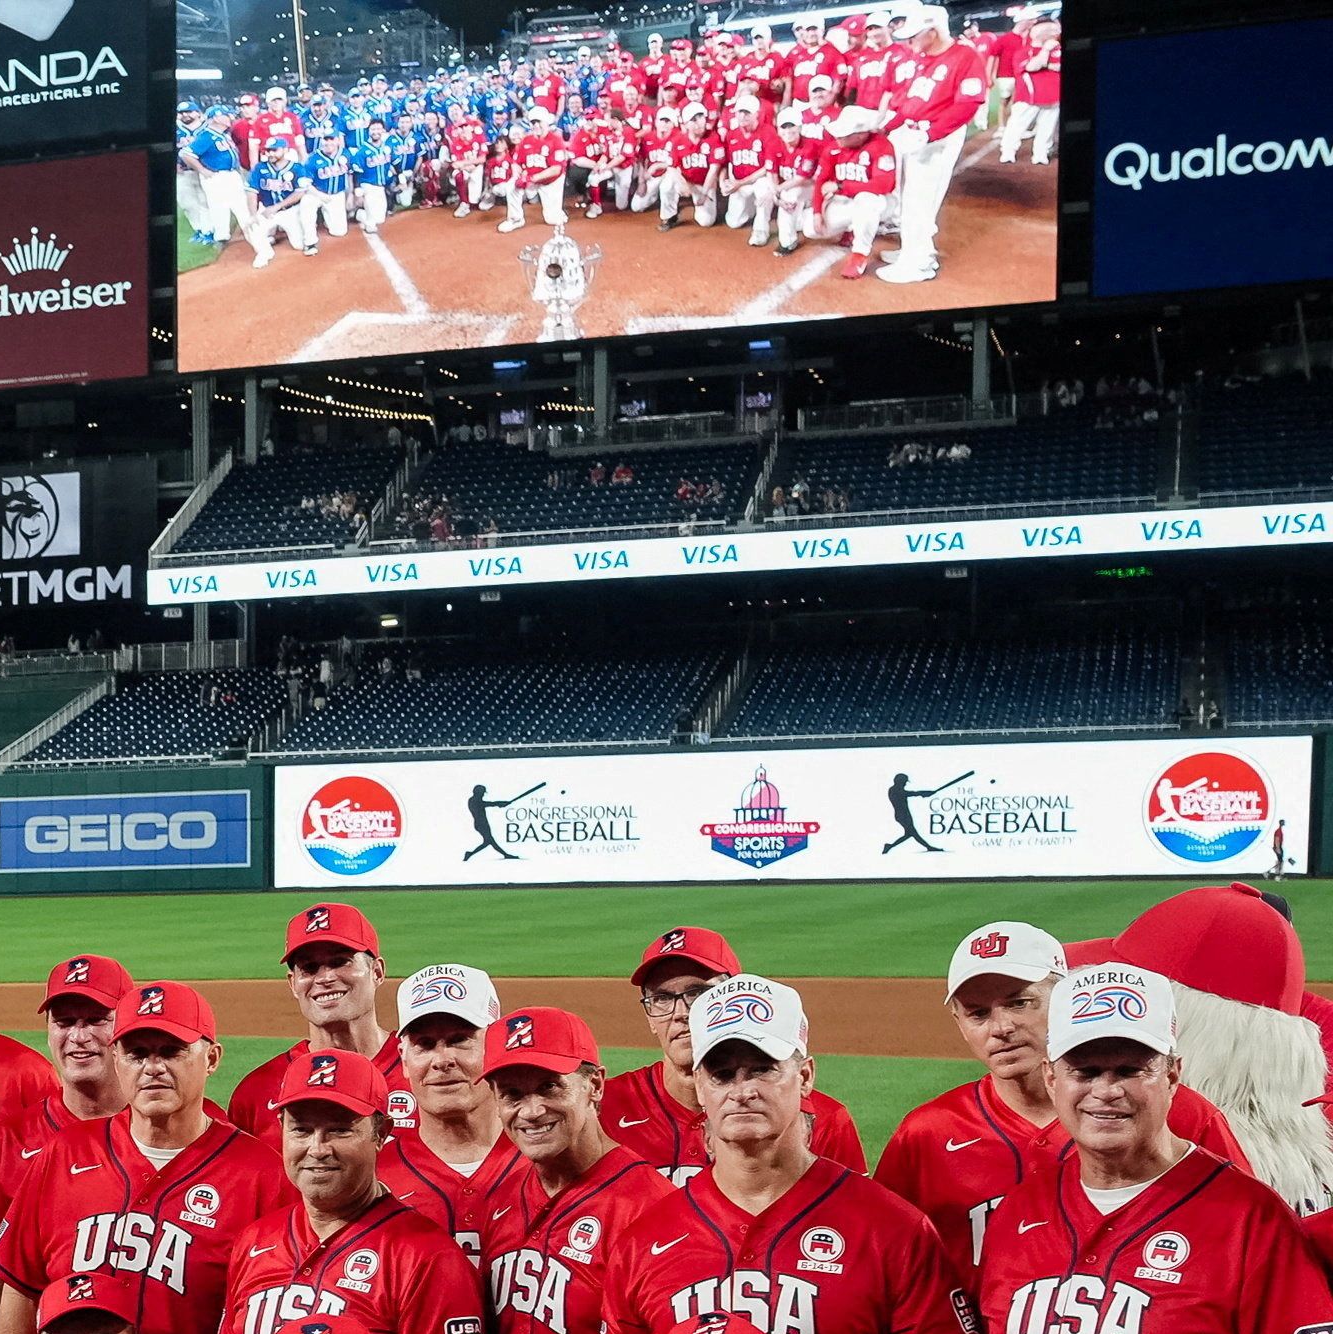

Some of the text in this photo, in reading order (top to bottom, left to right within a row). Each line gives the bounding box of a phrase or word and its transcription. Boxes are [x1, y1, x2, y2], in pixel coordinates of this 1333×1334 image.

[95, 82, 121, 96] INC
[682, 152, 709, 169] USA
[1104, 133, 1333, 190] Qualcom
[835, 161, 868, 183] USA
[1141, 519, 1202, 541] VISA
[1263, 512, 1326, 536] VISA
[906, 532, 965, 553] VISA
[1022, 525, 1083, 548] VISA
[682, 543, 738, 566] VISA
[792, 538, 850, 560] VISA
[469, 557, 523, 577] VISA
[574, 550, 629, 571] VISA
[266, 569, 318, 590] VISA
[366, 563, 418, 584] VISA
[169, 575, 219, 596] VISA
[505, 805, 638, 822] CONGRESSIONAL
[929, 795, 1075, 812] CONGRESSIONAL
[1180, 800, 1263, 815] BASEBALL
[25, 810, 217, 854] GEICO
[327, 819, 397, 833] BASEBALL
[506, 821, 641, 843] BASEBALL
[713, 823, 807, 835] CONGRESSIONAL
[930, 811, 1078, 835] BASEBALL
[734, 836, 785, 851] SPORTS
[972, 838, 1003, 847] GAME
[1028, 837, 1074, 847] CHARITY
[738, 850, 782, 859] FOR CHARITY
[413, 963, 467, 984] AMERICA
[1072, 969, 1147, 992] AMERICA
[707, 978, 774, 1002] AMERICA
[706, 993, 775, 1032] 250
[1071, 984, 1148, 1025] 250
[182, 1212, 216, 1228] 6-14-17
[71, 1211, 193, 1296] USA
[799, 1260, 843, 1274] 6-14-17
[1137, 1267, 1180, 1283] 6-14-17
